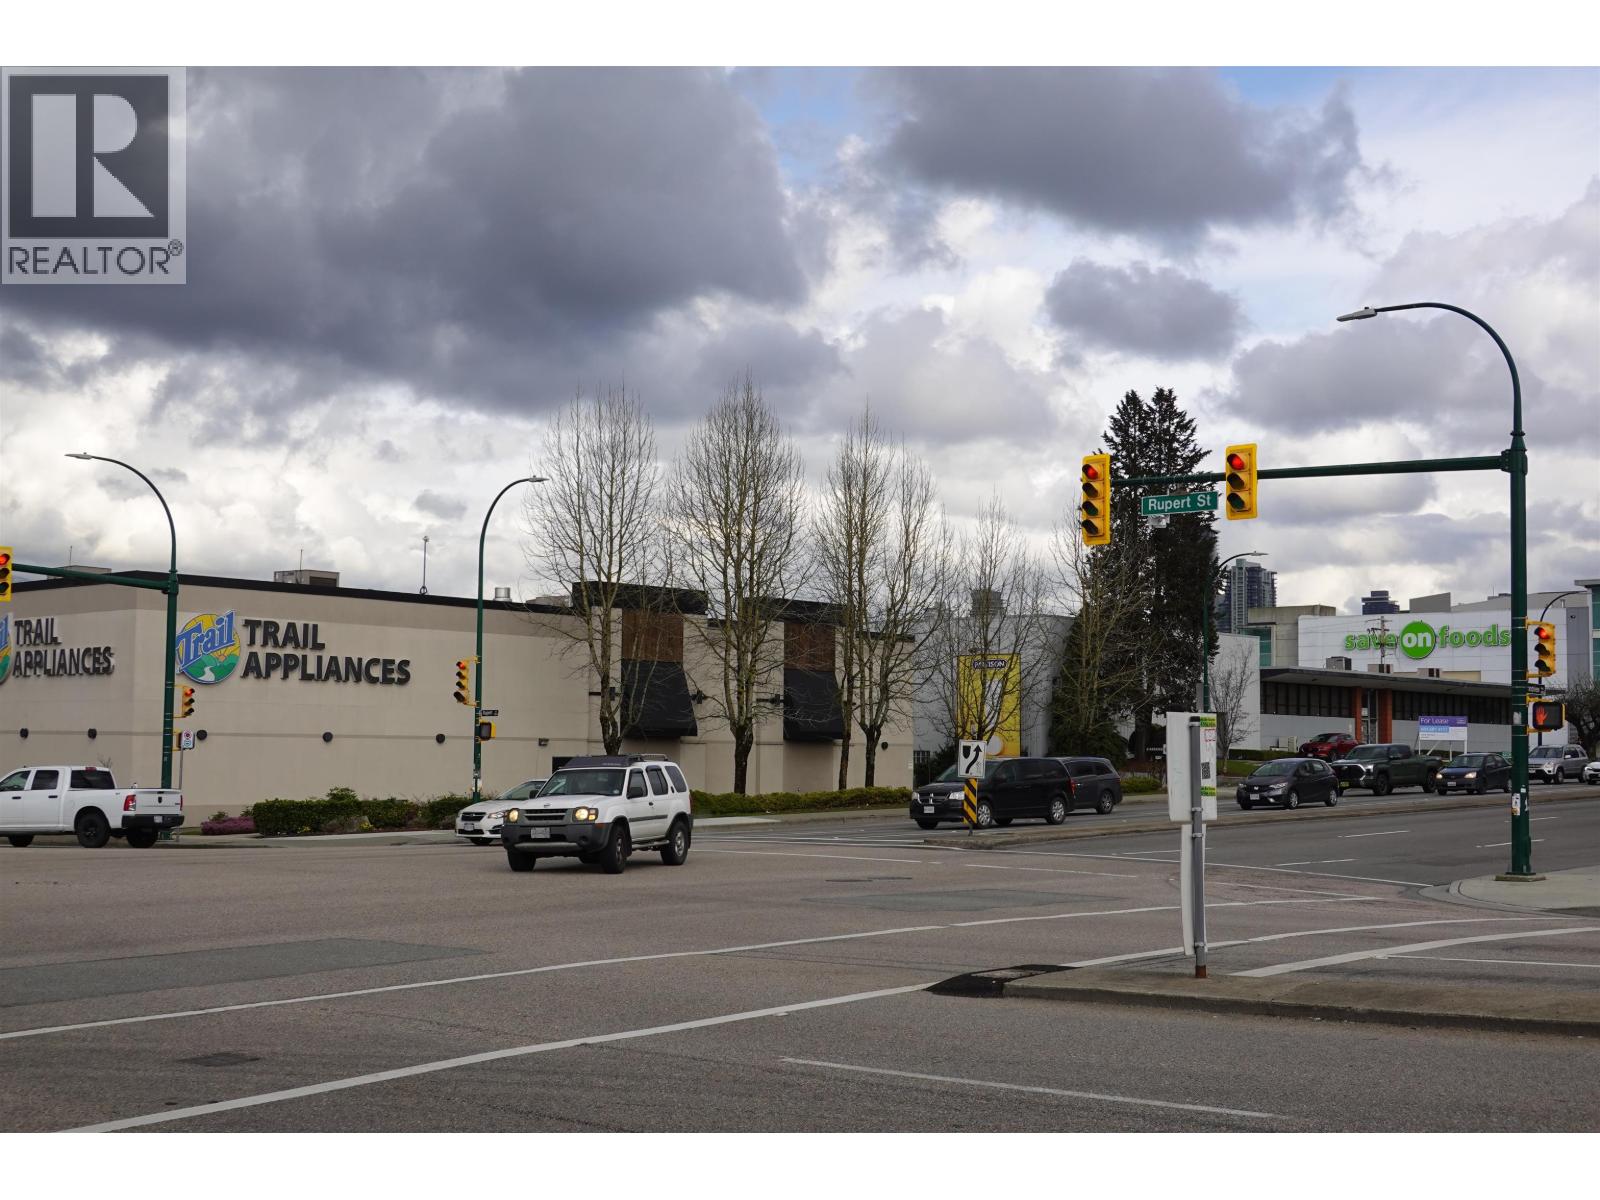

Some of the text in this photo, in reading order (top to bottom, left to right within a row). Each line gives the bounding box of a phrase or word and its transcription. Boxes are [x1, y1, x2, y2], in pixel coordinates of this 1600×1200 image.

[1149, 494, 1212, 512] Rupert St
[14, 618, 62, 646] TRAIL
[176, 611, 235, 669] Trail
[242, 618, 326, 651] TRAIL
[1344, 624, 1511, 651] save on foods
[12, 646, 116, 678] APPLIANCES
[240, 651, 411, 686] APPLIANCES
